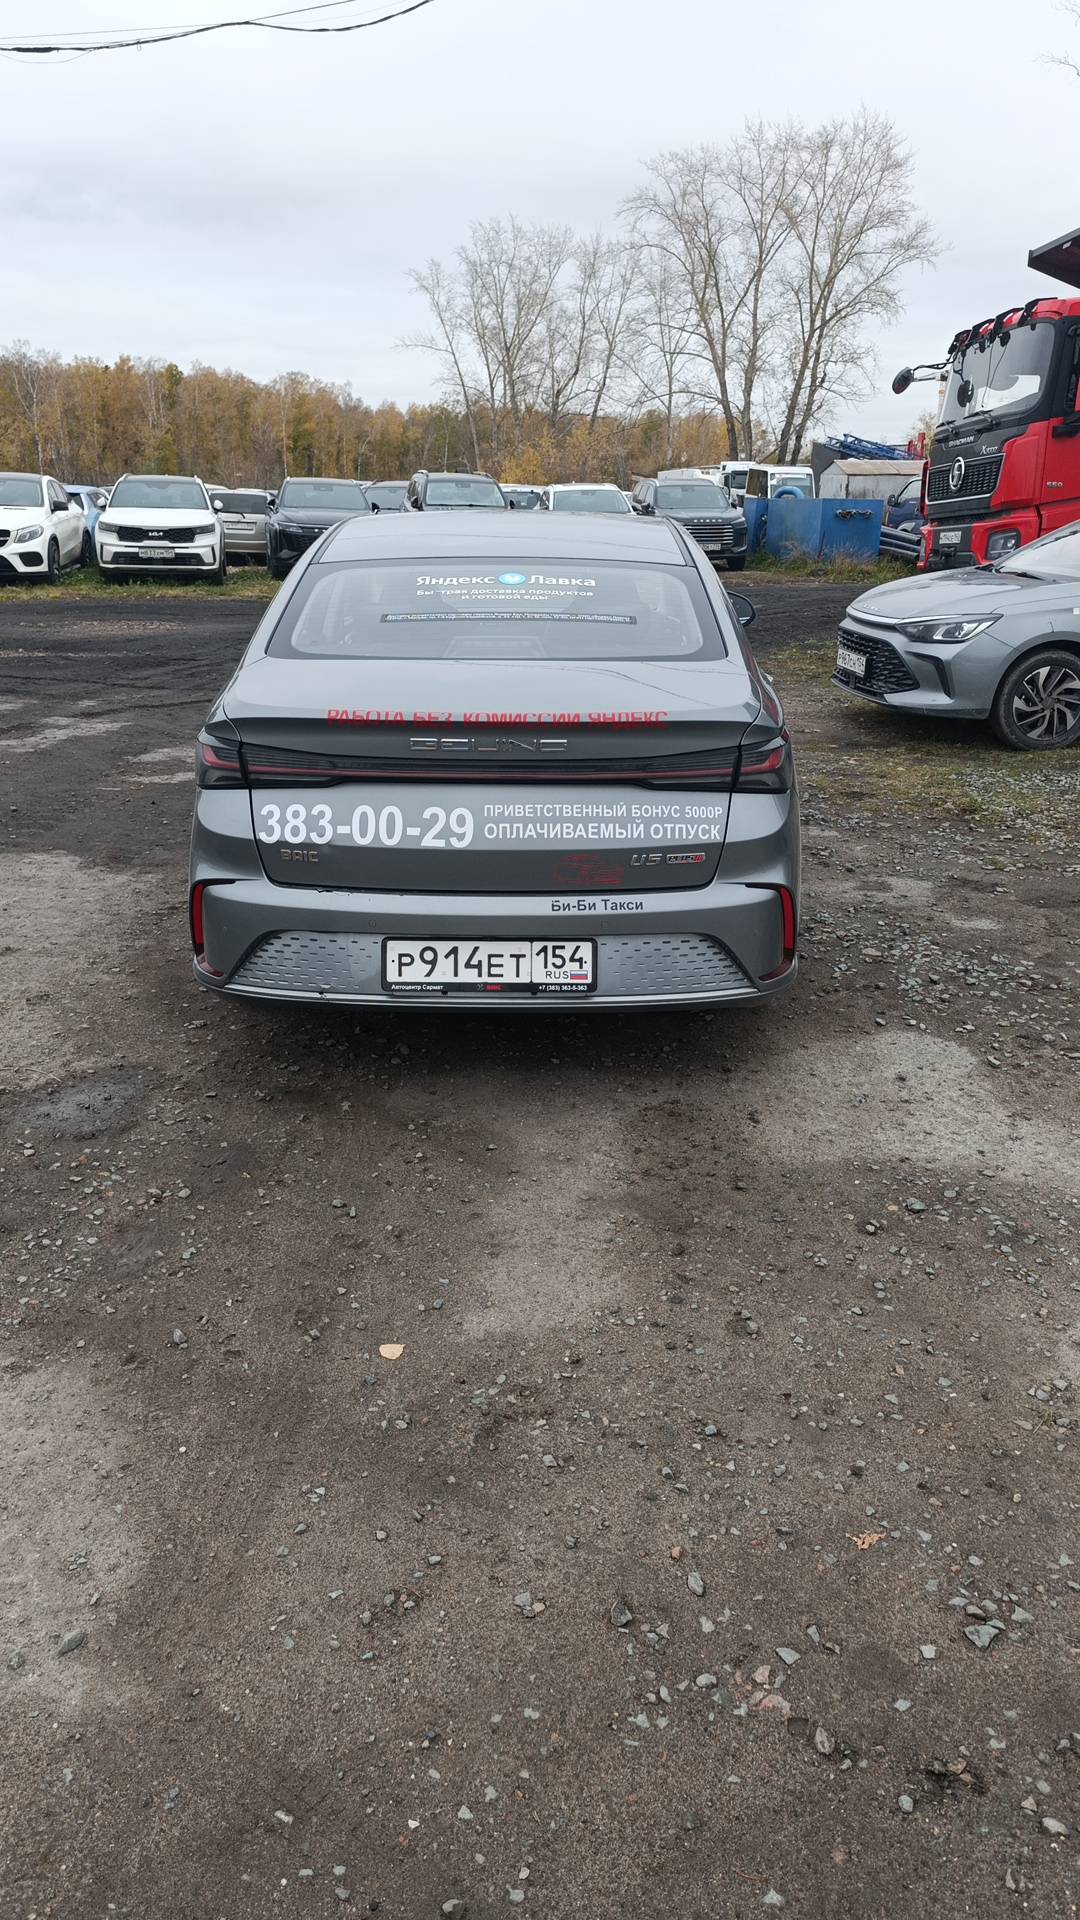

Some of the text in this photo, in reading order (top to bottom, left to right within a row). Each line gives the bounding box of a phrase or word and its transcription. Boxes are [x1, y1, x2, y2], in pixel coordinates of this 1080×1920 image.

[415, 575, 596, 587] Яндекс Лавка
[470, 587, 526, 595] доставка
[528, 588, 593, 597] продуктов
[327, 709, 670, 731] РАБОТА БЕЗ КОМИССИИ ЯНДЕКС
[484, 802, 723, 819] ПРИВЕТСТВЕННЫЙ БОНУС 5000Р
[258, 803, 474, 848] 383-00-29
[484, 819, 721, 840] ОПЛАЧИВАЕМЫЙ ОТПУСК
[279, 849, 319, 863] BAIC
[630, 854, 663, 866] U5
[551, 898, 644, 912] Би-Би Такси
[397, 945, 585, 978] Р914ЕТ 154
[545, 970, 570, 980] RUS
